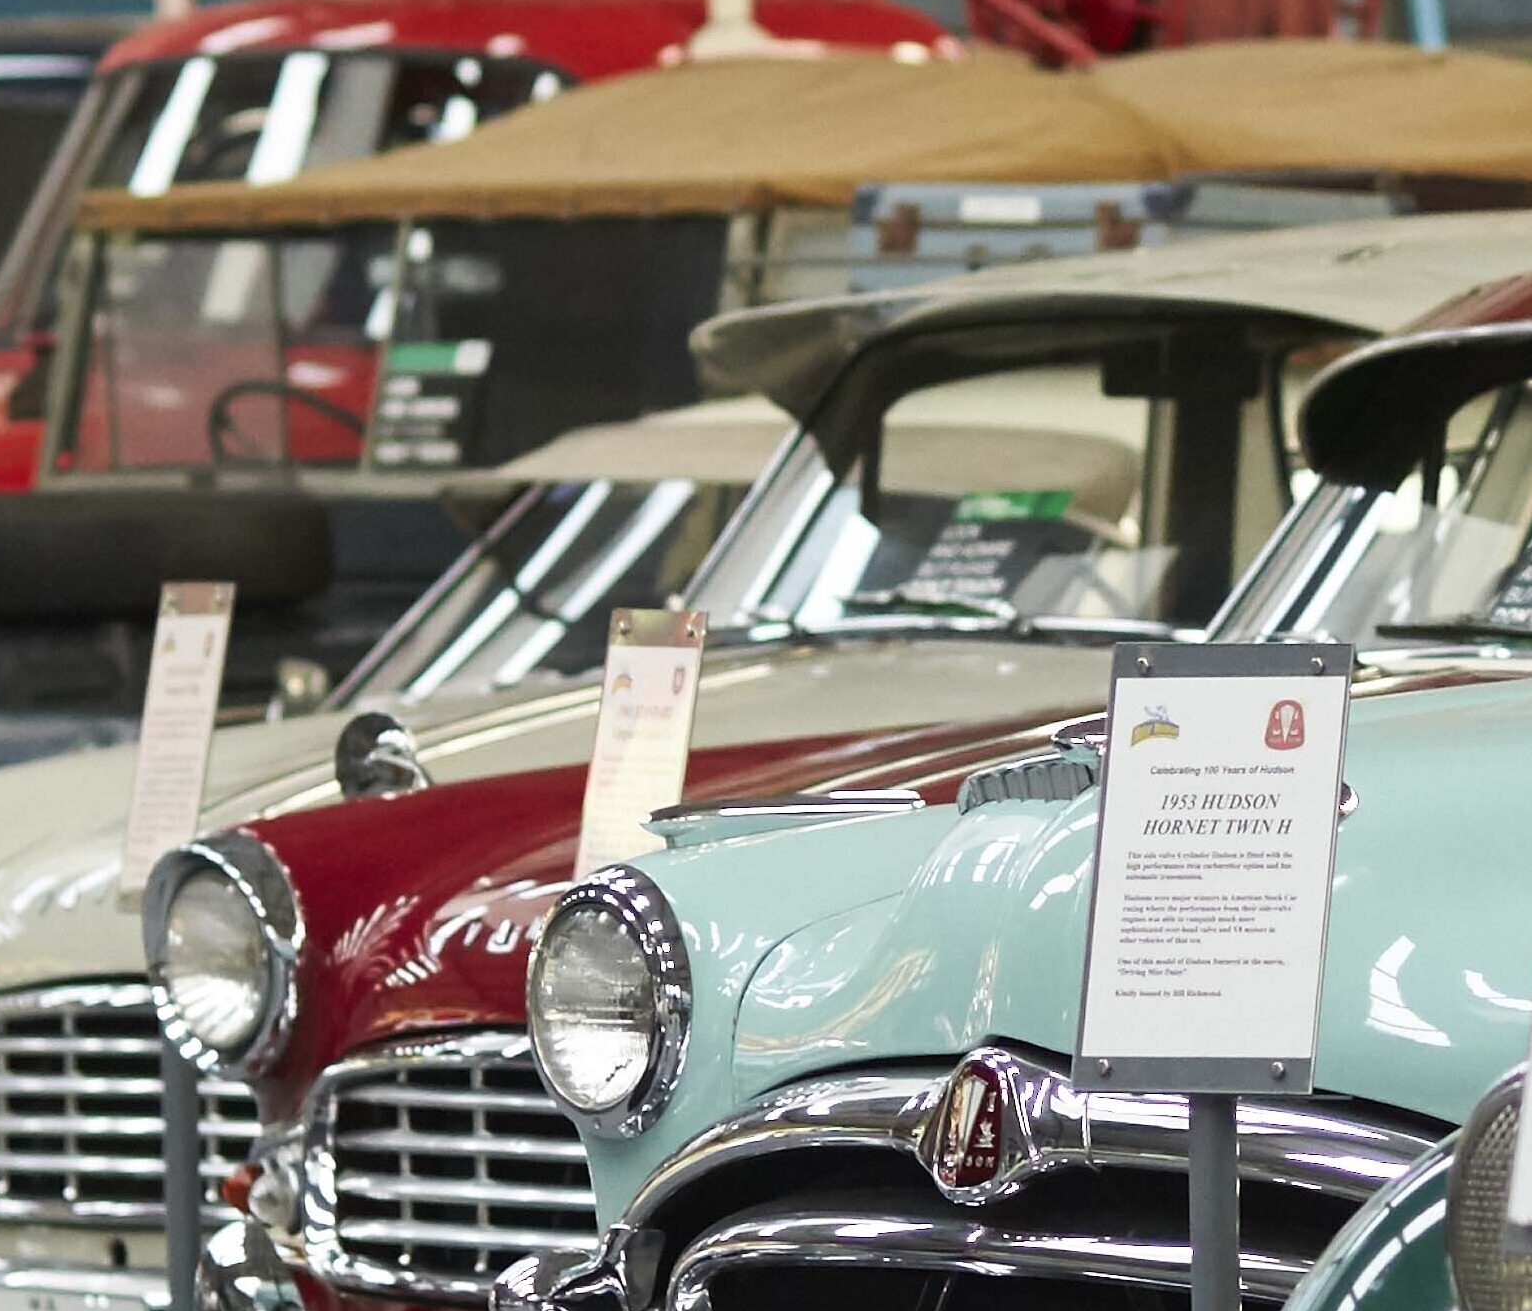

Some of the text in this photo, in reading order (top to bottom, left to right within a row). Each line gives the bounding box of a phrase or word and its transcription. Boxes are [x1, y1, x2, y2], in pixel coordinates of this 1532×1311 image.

[1150, 765, 1295, 777] Celebrating 100 Years of Hudson
[1161, 793, 1281, 810] 1953 HUDSON
[1143, 818, 1293, 835] HORNET TWIN H
